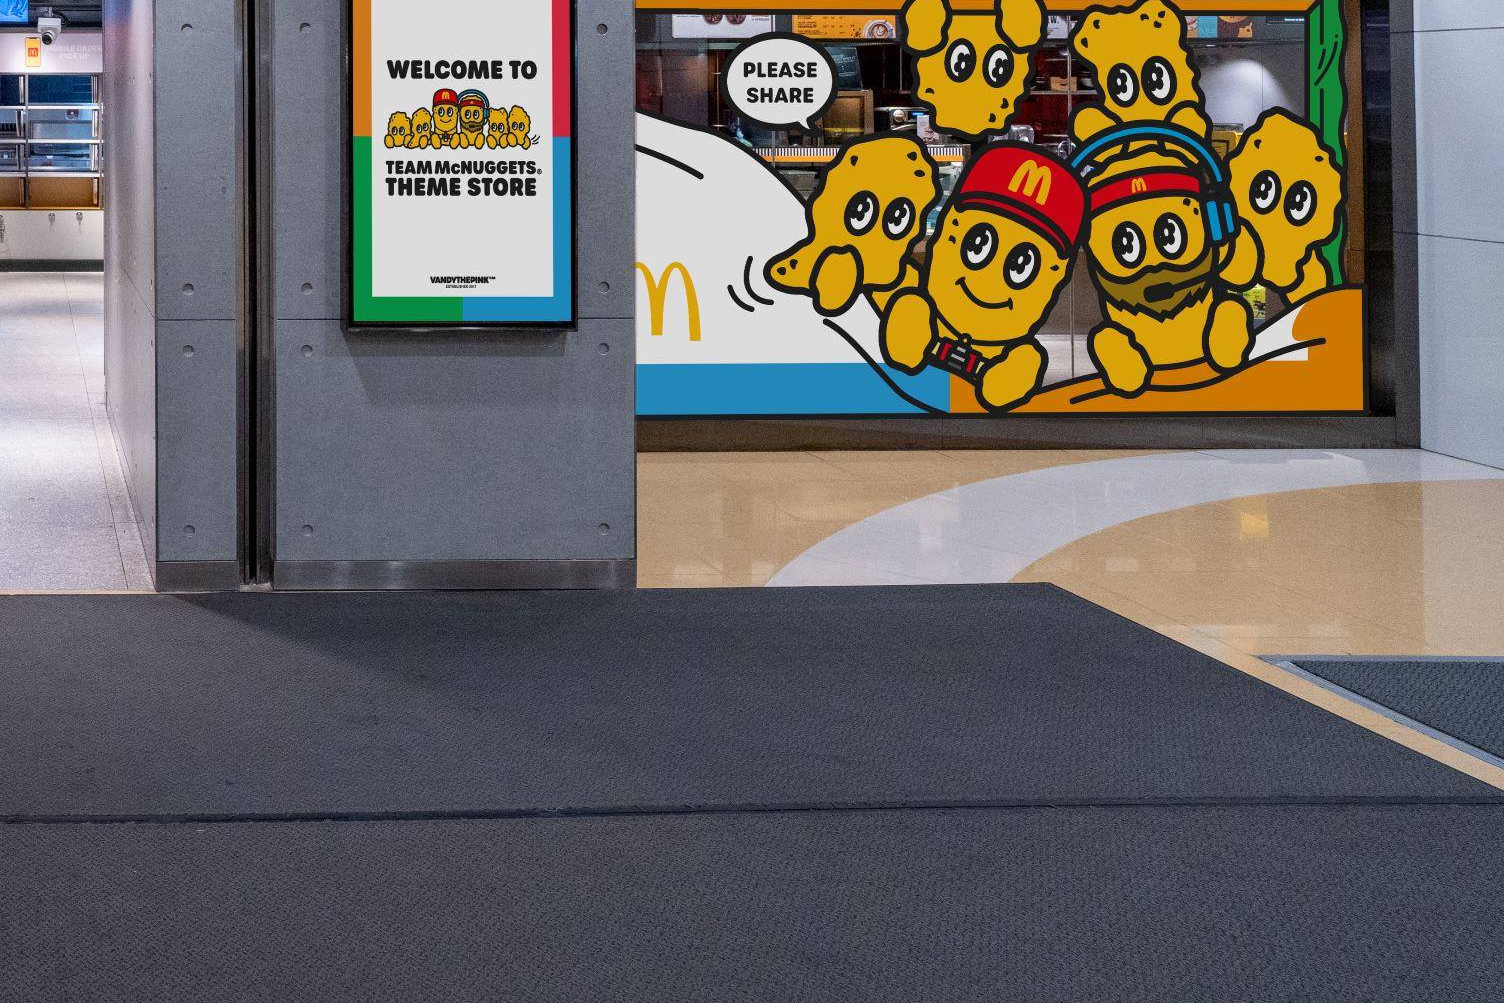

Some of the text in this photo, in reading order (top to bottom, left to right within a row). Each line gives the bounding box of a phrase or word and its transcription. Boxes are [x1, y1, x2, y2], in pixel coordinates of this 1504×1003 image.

[387, 60, 537, 79] WELCOME TO
[743, 62, 818, 78] PLEASE
[746, 87, 814, 103] SHARE
[386, 161, 432, 175] TEAM
[386, 178, 537, 196] THEME STORE
